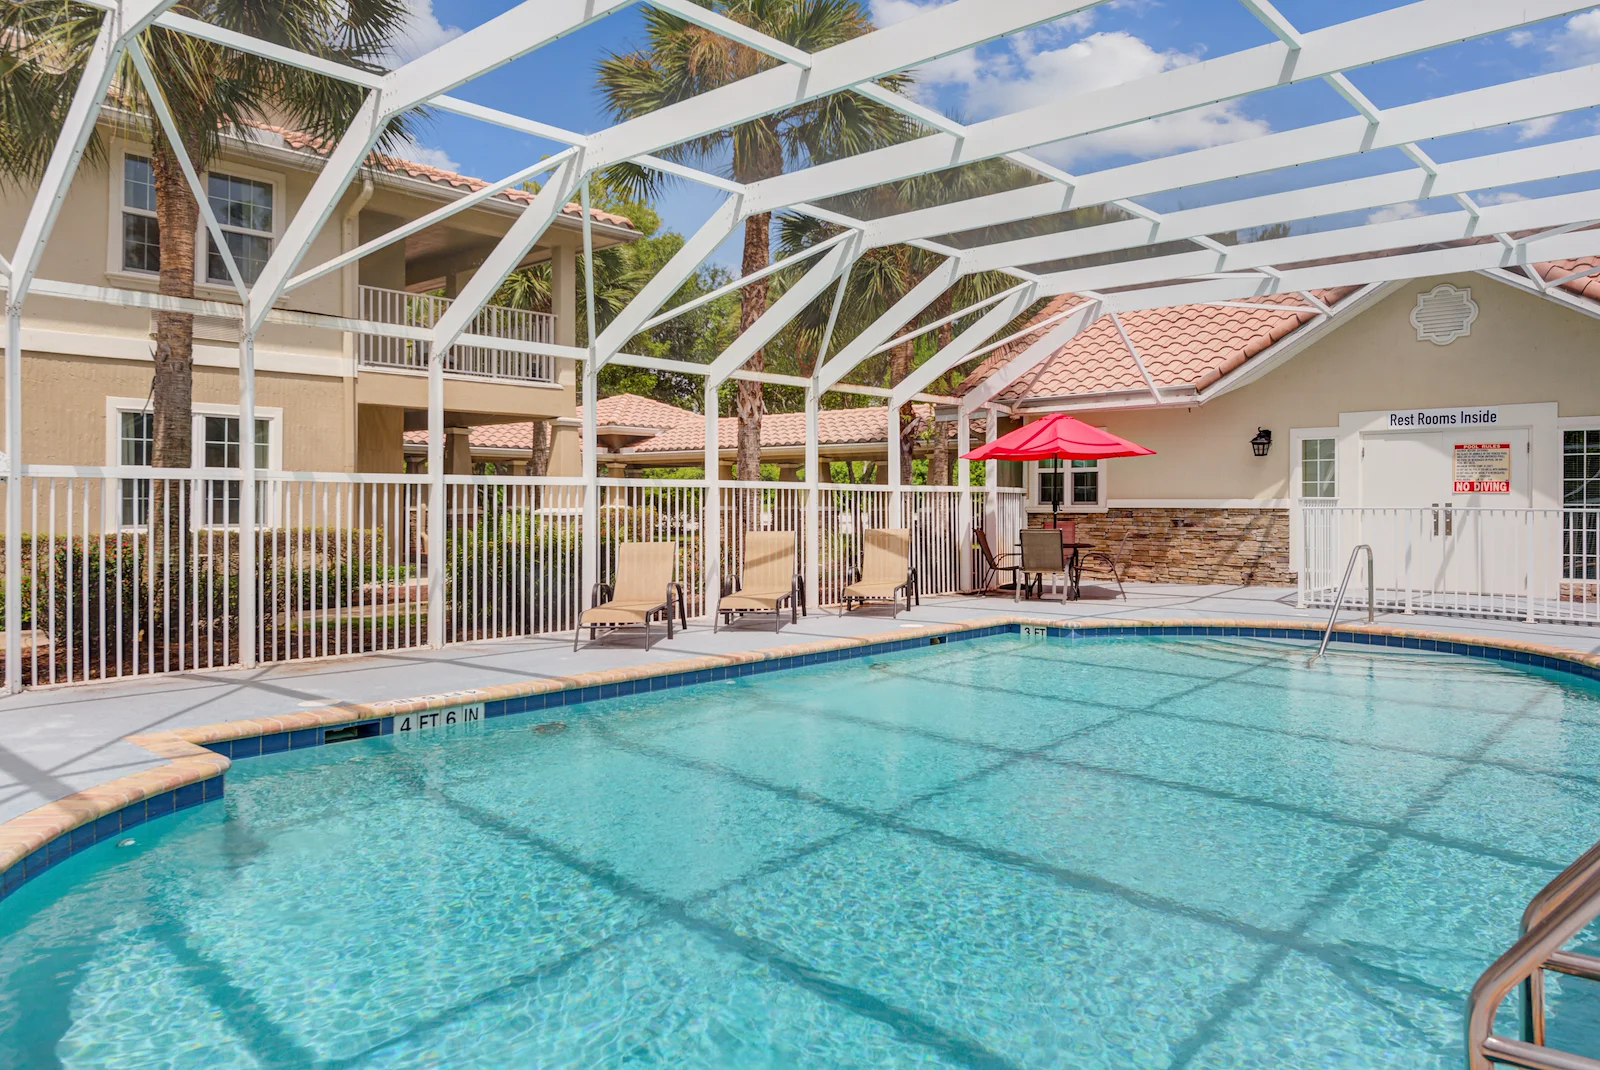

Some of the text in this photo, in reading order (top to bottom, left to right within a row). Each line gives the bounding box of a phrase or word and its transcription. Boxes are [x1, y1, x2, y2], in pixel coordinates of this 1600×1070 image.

[1390, 410, 1497, 426] Rest Rooms Inside
[1456, 482, 1507, 491] NO DIVING
[1024, 627, 1030, 635] 3
[400, 707, 479, 732] 4 FT 6 IN
